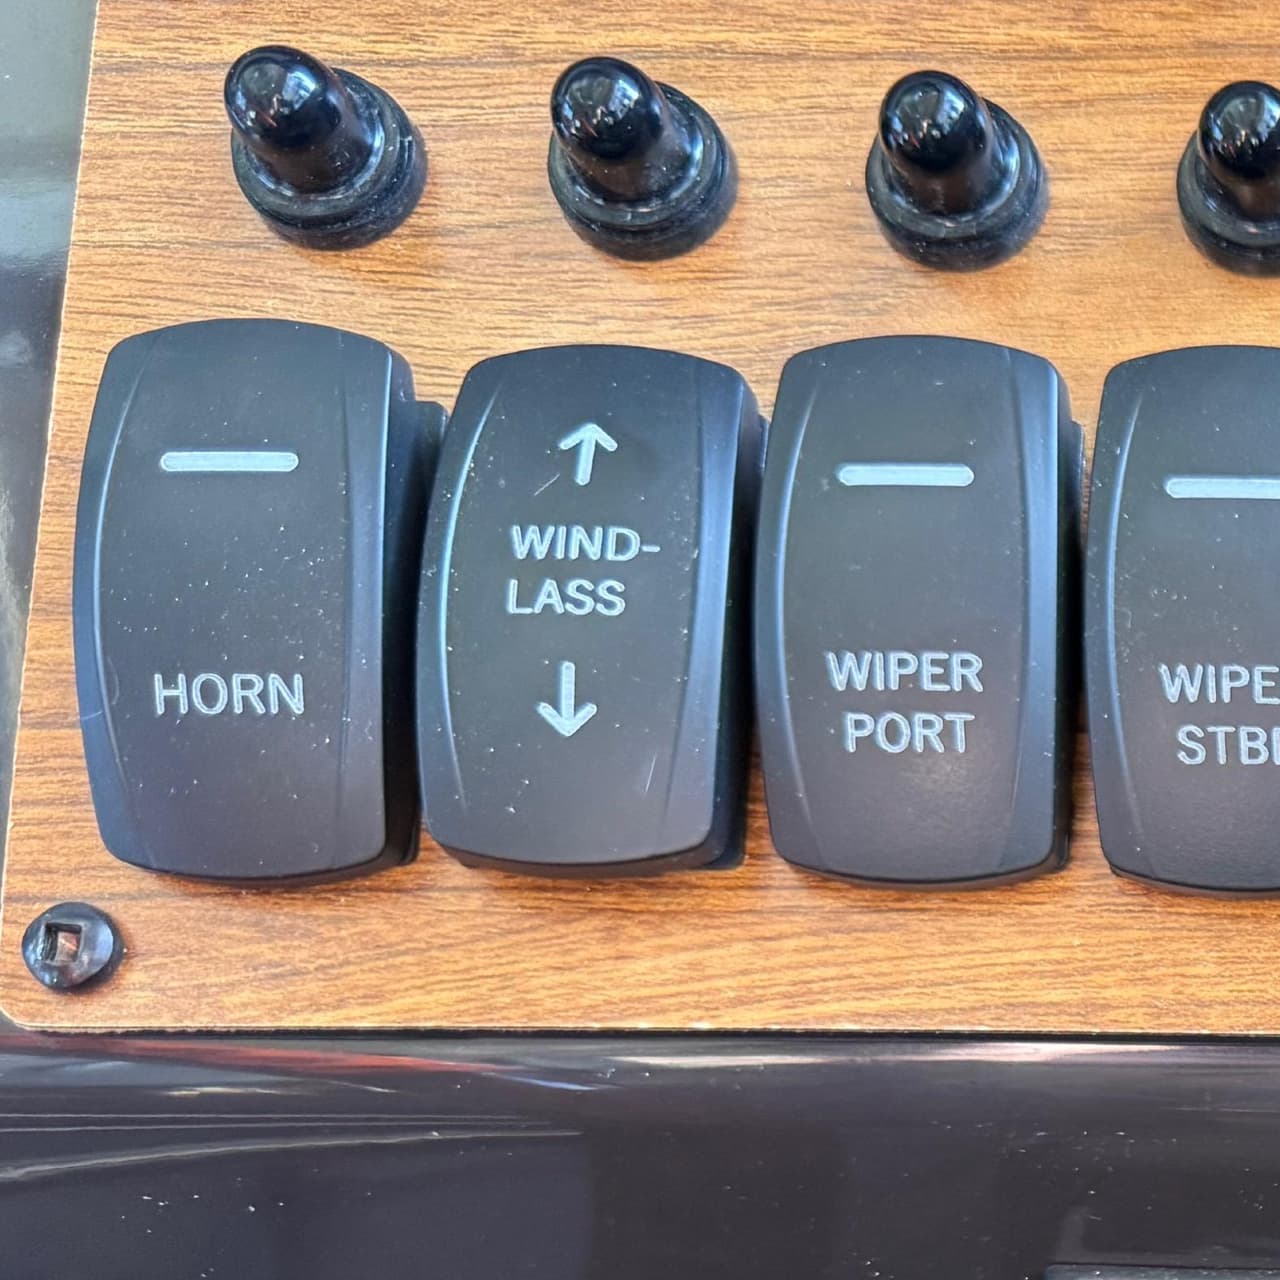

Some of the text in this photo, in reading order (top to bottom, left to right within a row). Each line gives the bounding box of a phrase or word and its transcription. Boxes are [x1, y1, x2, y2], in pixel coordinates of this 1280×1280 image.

[510, 525, 661, 561] WIND-
[506, 579, 626, 615] LASS
[827, 651, 983, 692] WIPER
[153, 673, 304, 714] HORN
[844, 712, 975, 754] PORT
